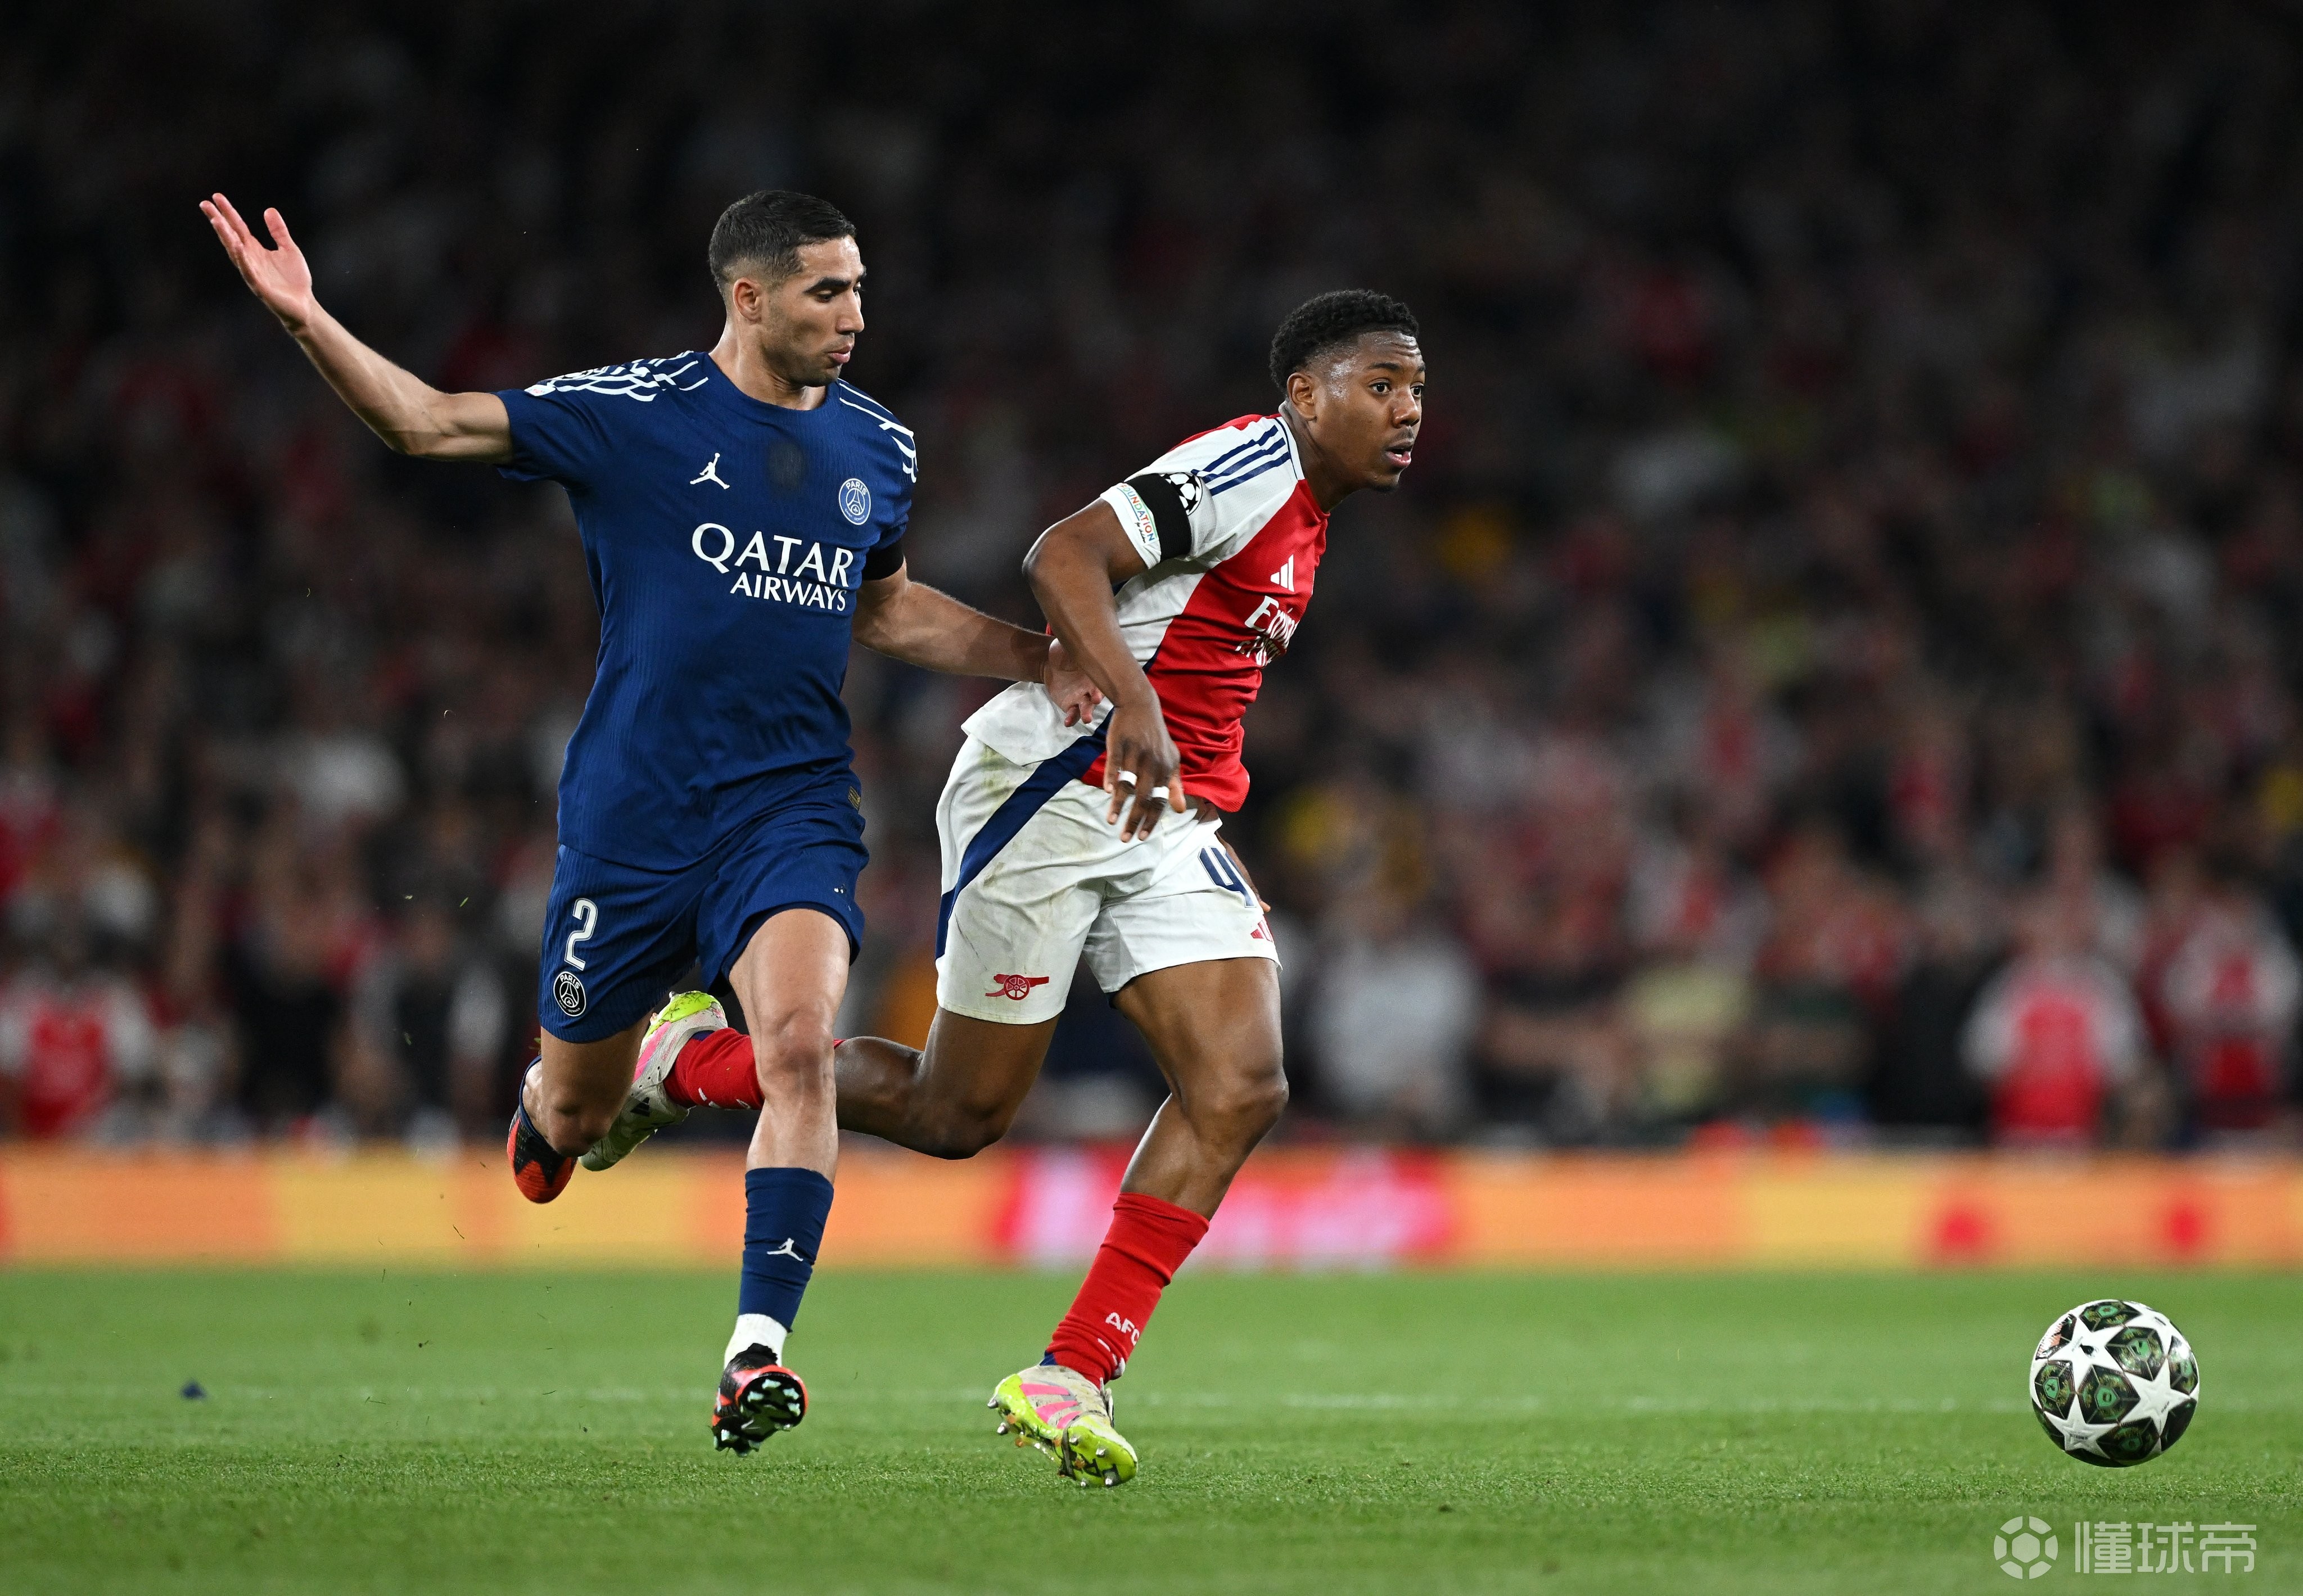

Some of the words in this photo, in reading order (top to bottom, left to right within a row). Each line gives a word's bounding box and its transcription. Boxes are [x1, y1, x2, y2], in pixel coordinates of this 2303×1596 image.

[846, 481, 867, 495] PARIS
[1120, 485, 1155, 541] FOUNDATION
[692, 523, 854, 587] QATAR
[730, 572, 847, 612] AIRWAYS
[564, 898, 598, 971] 2
[560, 974, 580, 989] PARIS
